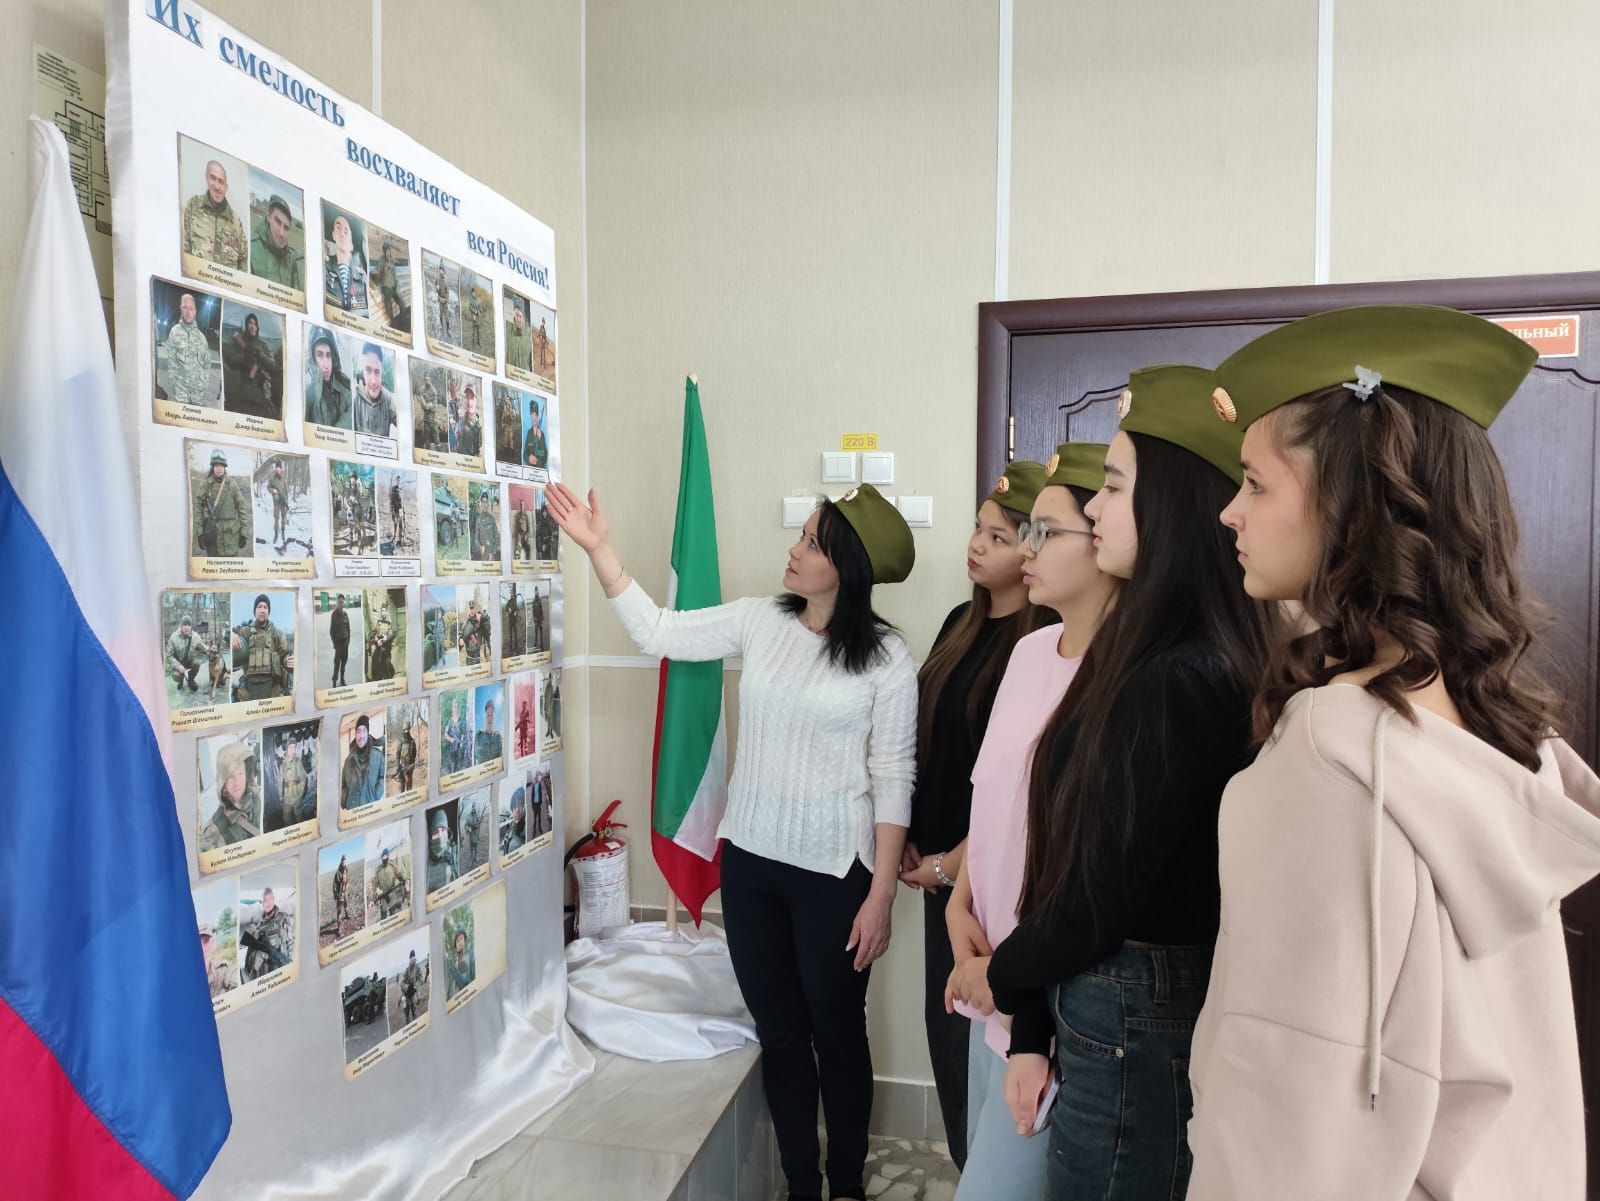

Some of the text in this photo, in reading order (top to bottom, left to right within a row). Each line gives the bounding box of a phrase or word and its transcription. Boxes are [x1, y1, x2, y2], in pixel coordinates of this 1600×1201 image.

[154, 0, 345, 127] Их смелость
[346, 138, 461, 216] восхваляет
[467, 230, 550, 290] вся Россия!
[1508, 322, 1570, 339] льный
[845, 437, 864, 447] 220
